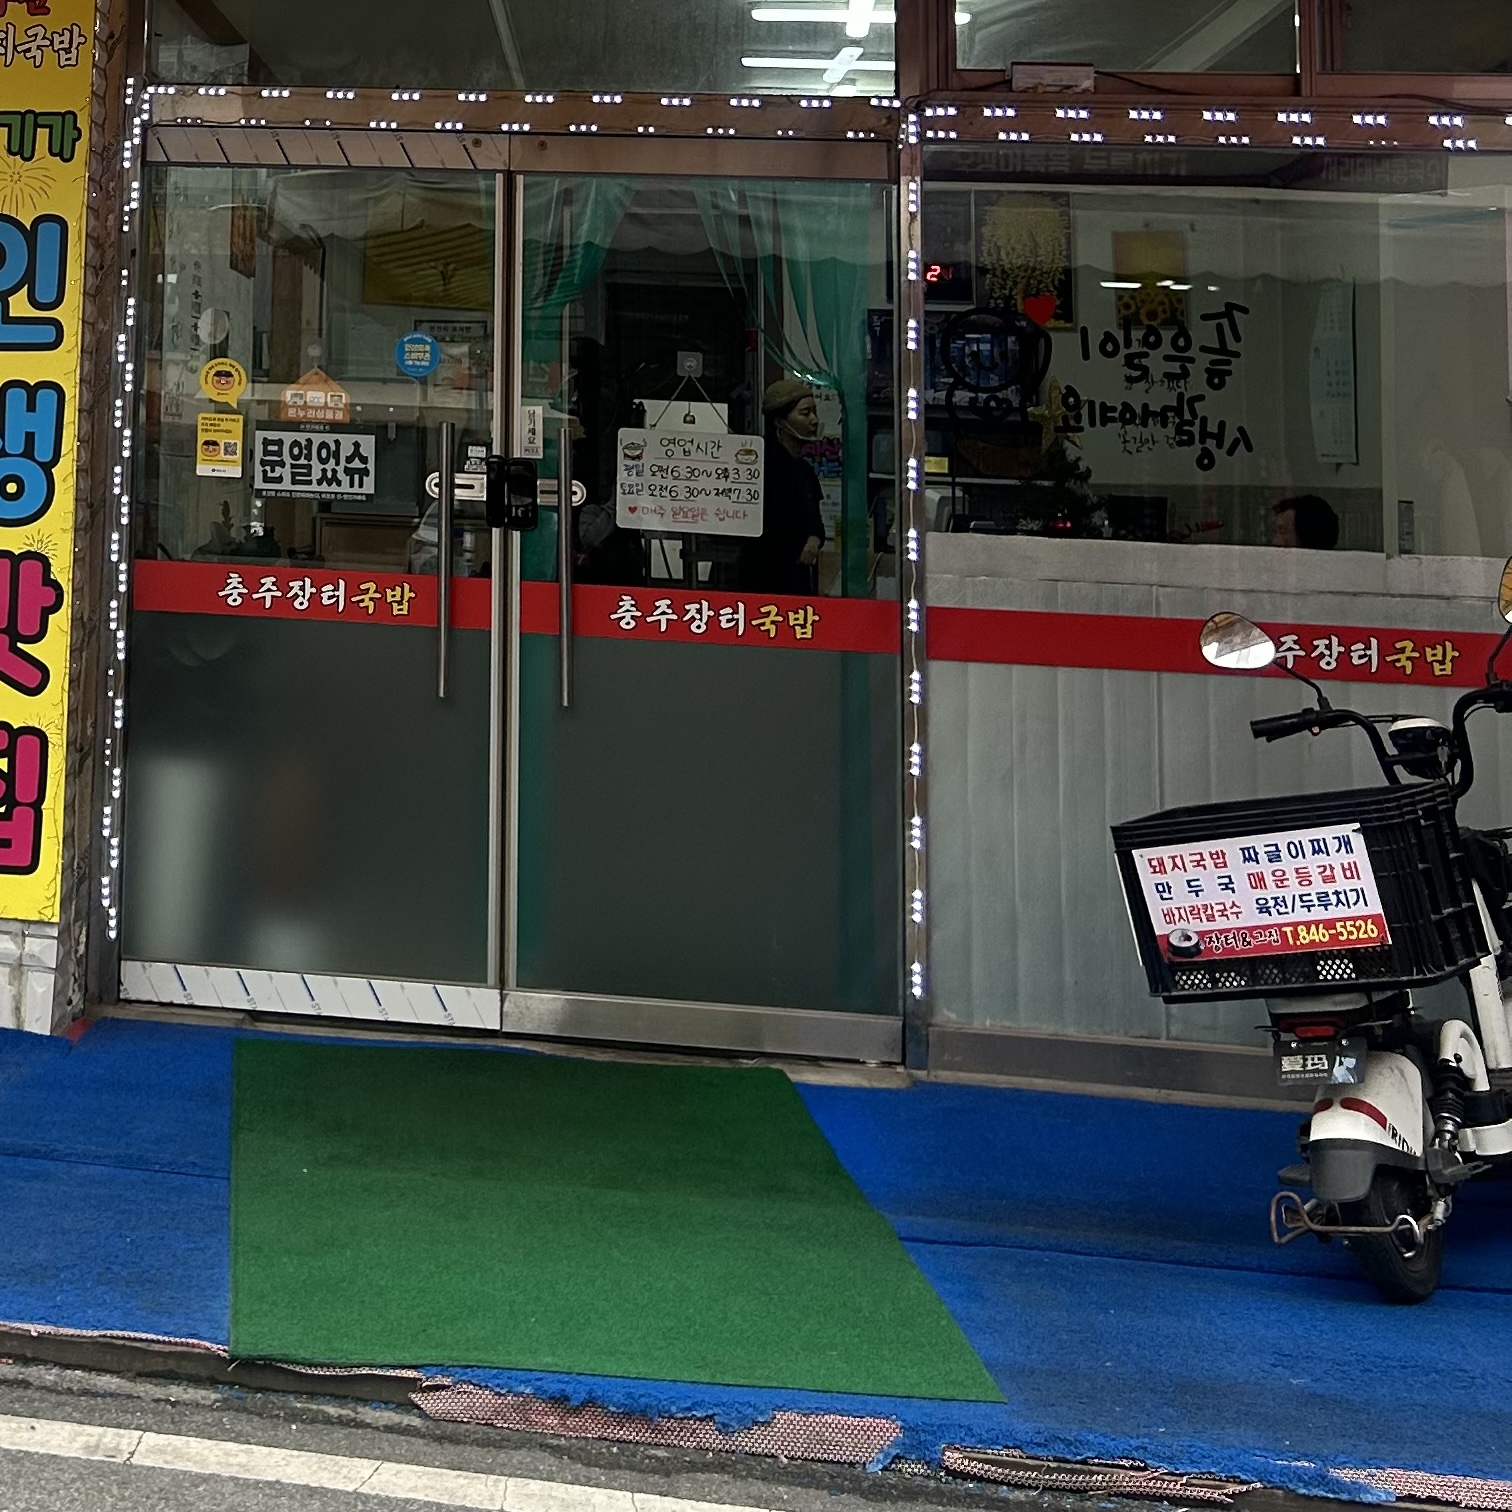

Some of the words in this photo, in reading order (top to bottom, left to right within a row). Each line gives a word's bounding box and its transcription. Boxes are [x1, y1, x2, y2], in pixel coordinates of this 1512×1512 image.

[660, 437, 723, 459] 영업시간
[259, 437, 370, 489] 문열었슈
[623, 463, 645, 477] 평일
[620, 482, 645, 496] 토요일
[641, 505, 666, 520] 매주
[670, 505, 709, 521] 일요일은
[714, 506, 749, 522] 쉽니다
[217, 572, 416, 617] 충주장터국밥
[609, 593, 820, 640] 충주장터국밥
[1147, 849, 1229, 876] 돼지국밥
[1239, 834, 1354, 866] 짜글이찌개
[1247, 860, 1362, 891] 매운등갈비
[1161, 900, 1244, 926] 바지락칼국수
[1282, 919, 1379, 947] T.846-5526
